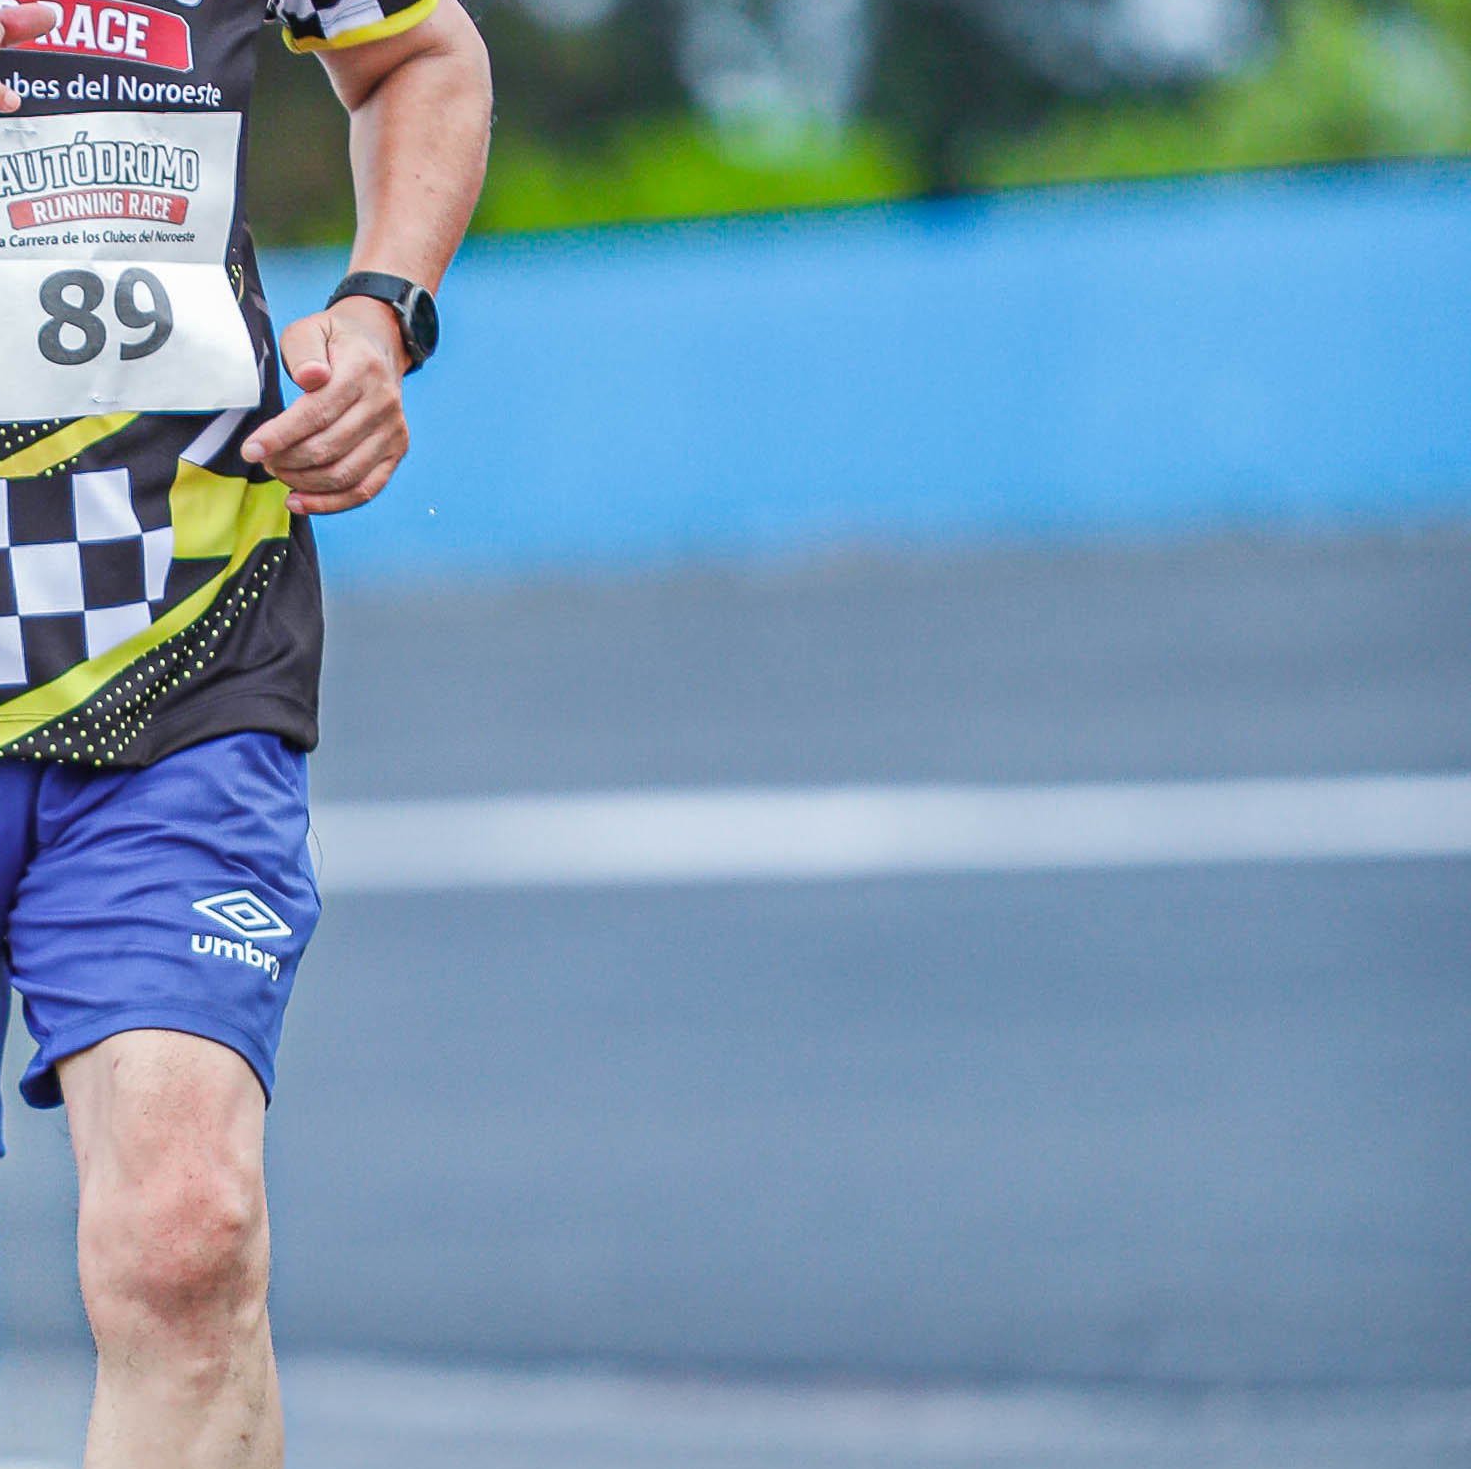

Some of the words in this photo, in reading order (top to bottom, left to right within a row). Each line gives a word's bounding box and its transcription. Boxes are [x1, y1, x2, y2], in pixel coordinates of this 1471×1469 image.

[67, 74, 109, 101] del
[117, 76, 222, 107] Noroeste
[31, 191, 124, 225] RUNNING
[128, 192, 172, 221] RACE
[10, 233, 58, 247] Carrera
[62, 231, 78, 244] de
[82, 230, 100, 244] los
[103, 229, 136, 244] Clubes
[139, 230, 153, 243] del
[155, 230, 196, 243] Noroeste
[38, 267, 174, 365] 89
